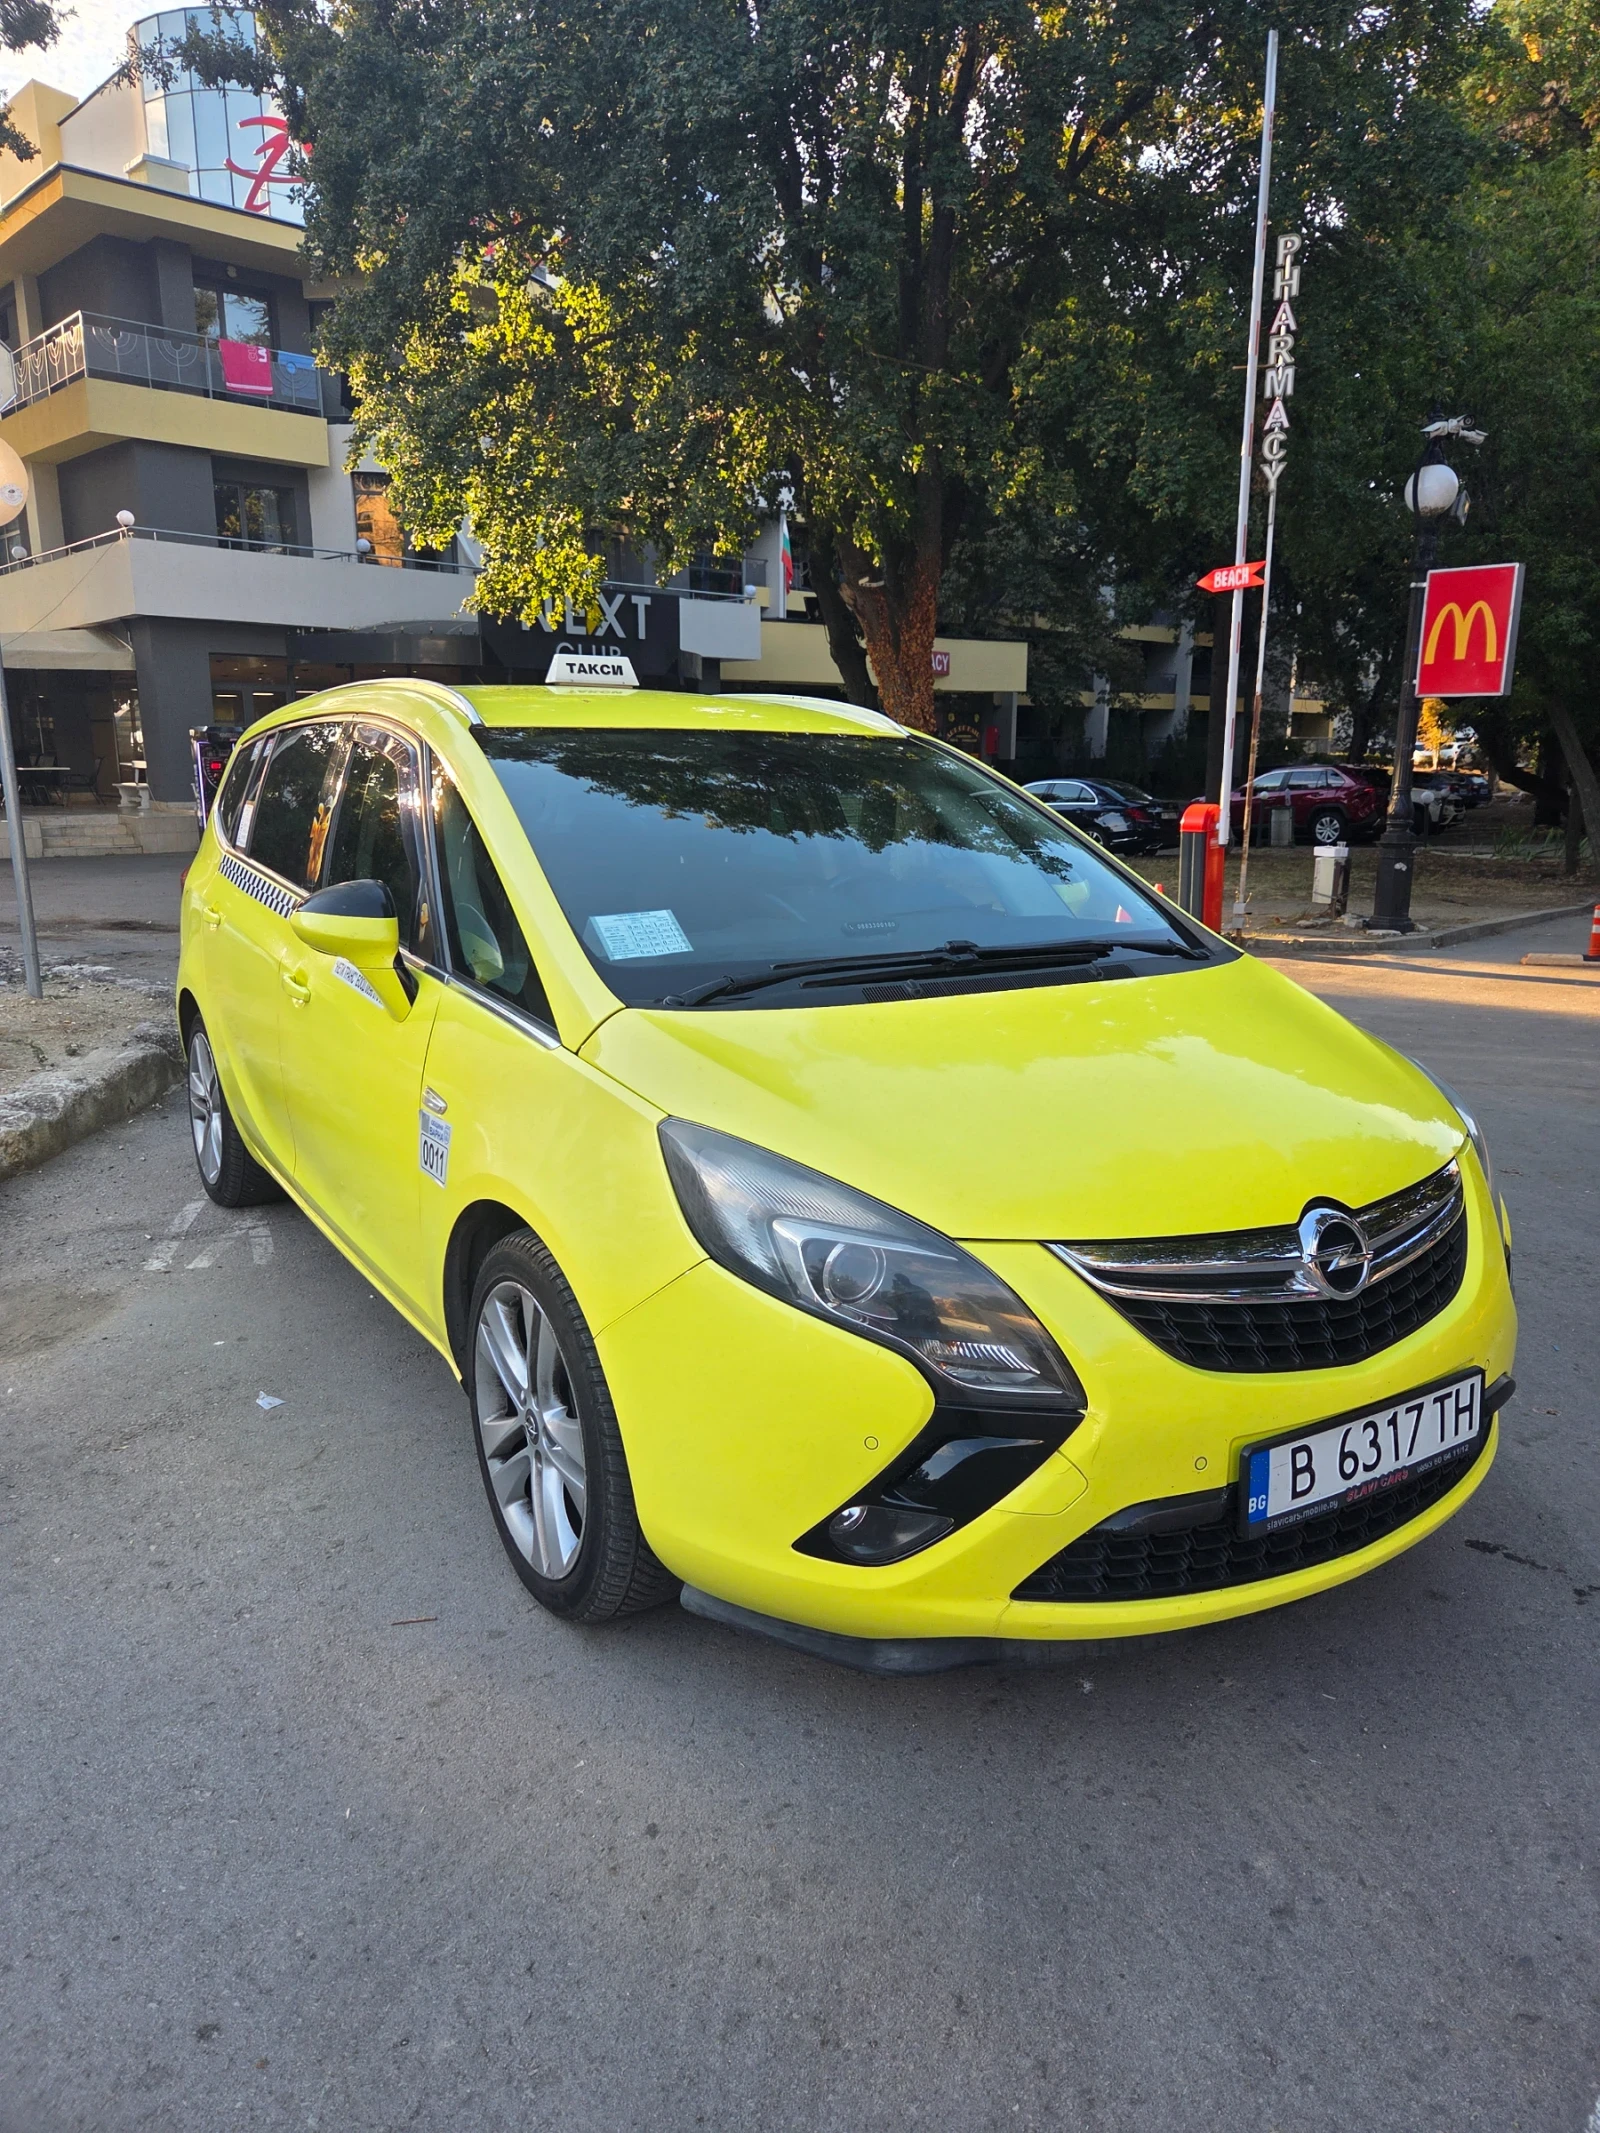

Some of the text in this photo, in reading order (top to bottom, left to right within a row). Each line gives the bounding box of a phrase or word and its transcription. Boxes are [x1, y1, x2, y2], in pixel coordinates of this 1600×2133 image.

[1260, 233, 1302, 493] PHARMACY
[1213, 566, 1250, 589] BEACH
[566, 662, 624, 676] ТАКСИ
[423, 1139, 444, 1178] 0011
[1290, 1382, 1476, 1501] B 6317 TH
[1346, 1469, 1409, 1502] SLAVI CARS
[1248, 1494, 1267, 1514] BG
